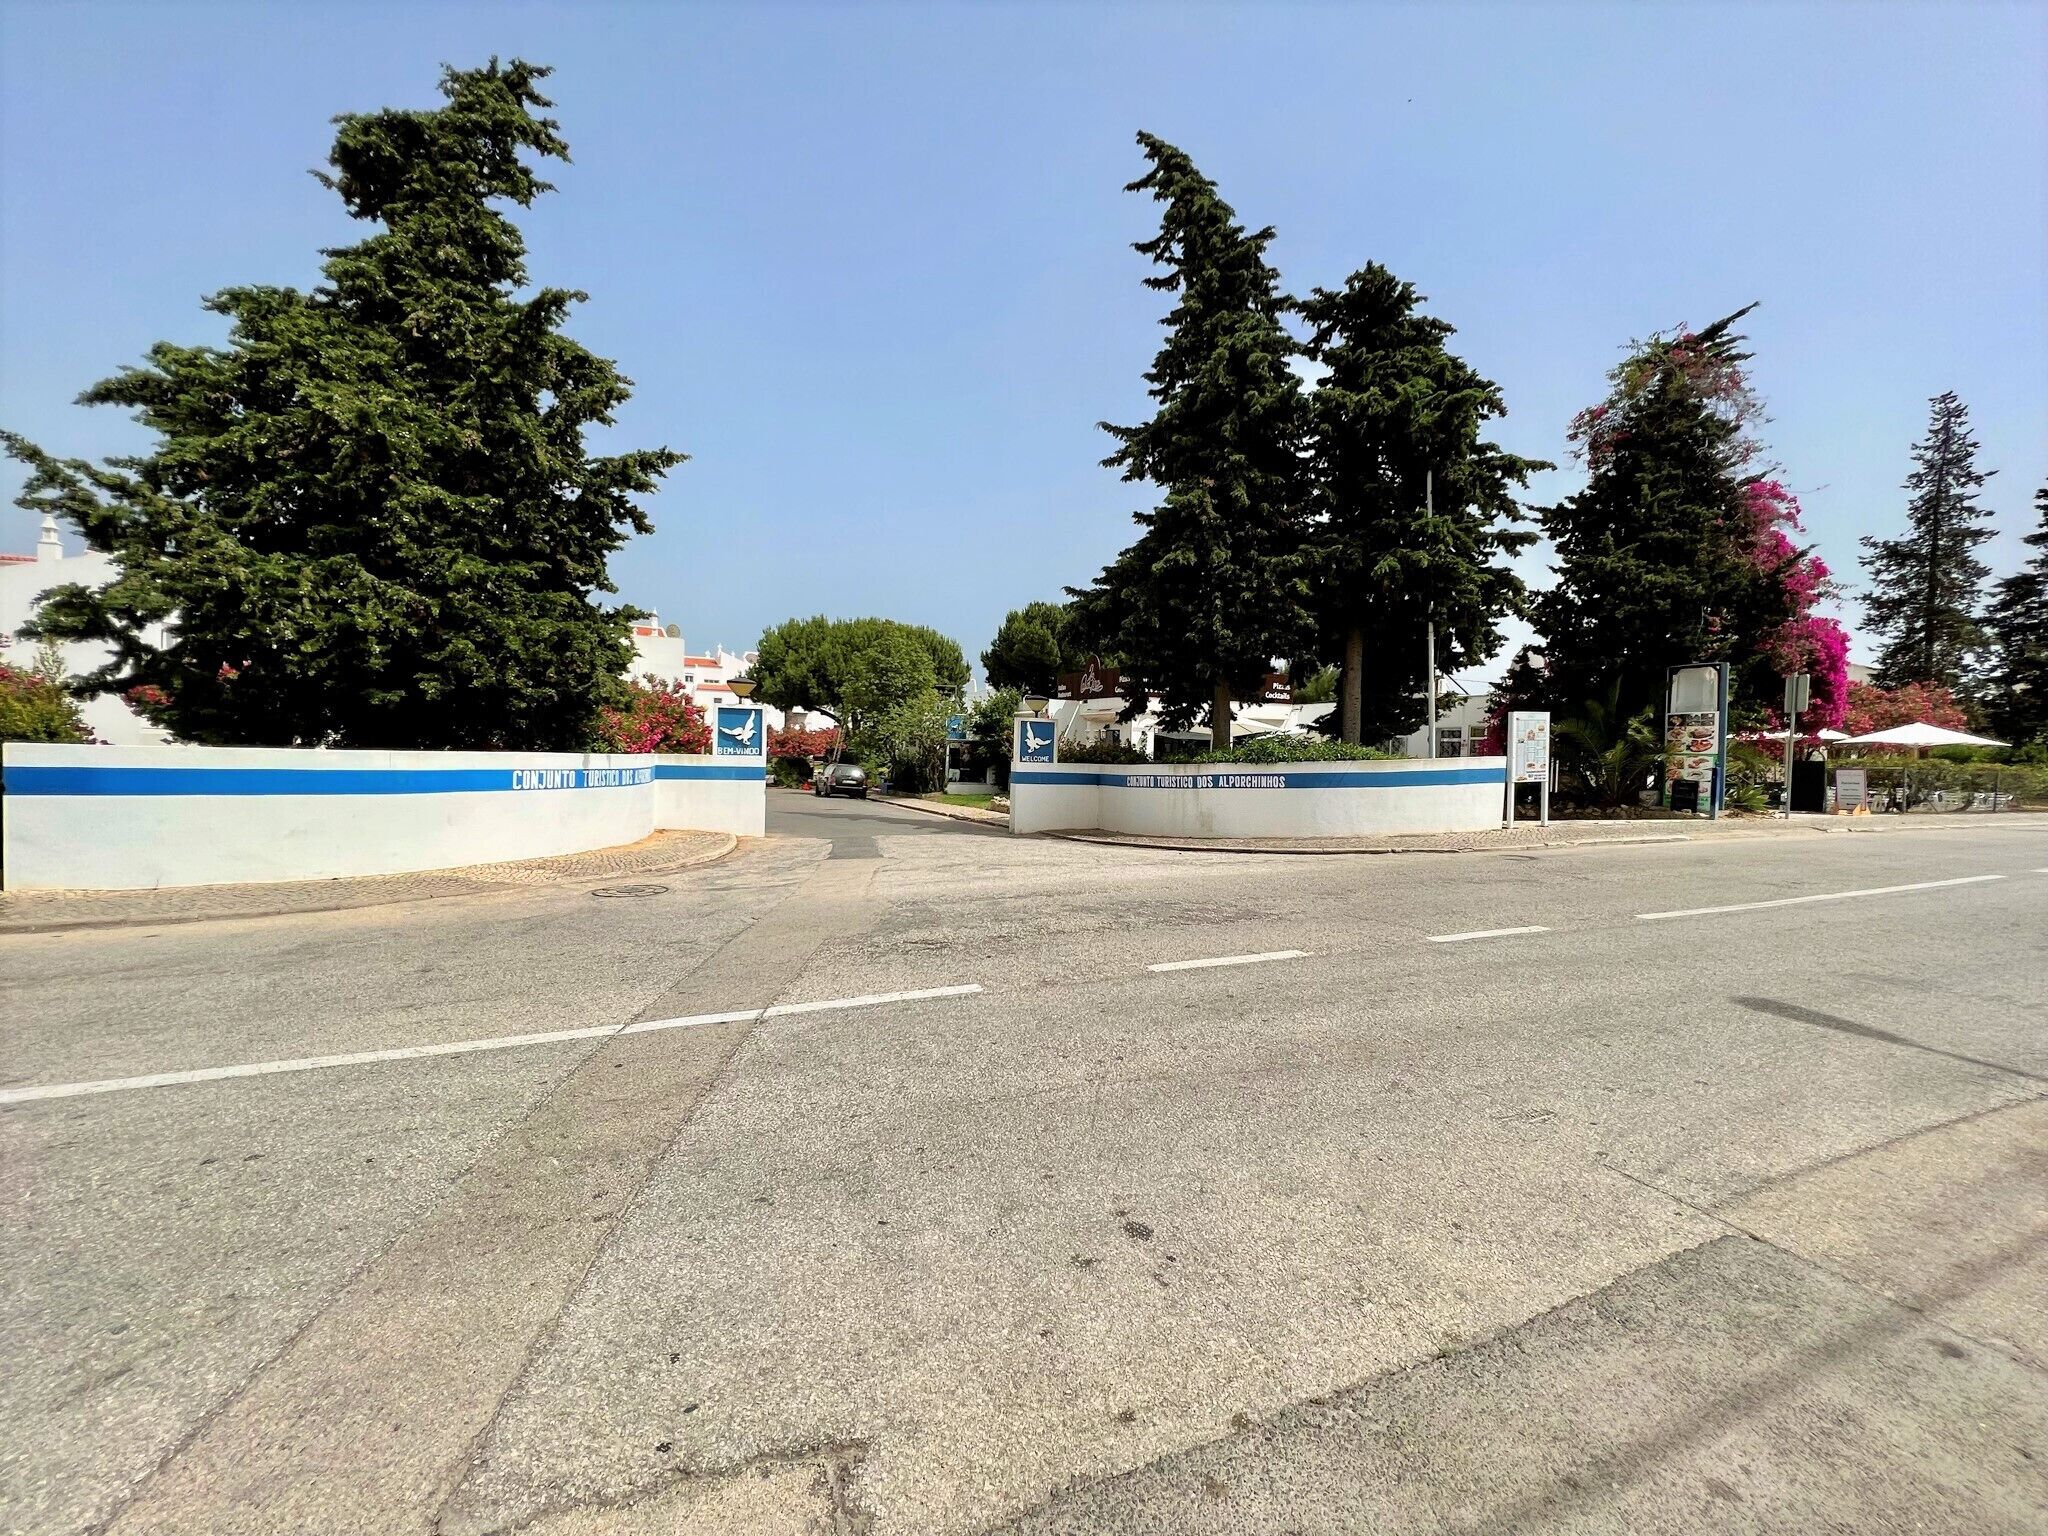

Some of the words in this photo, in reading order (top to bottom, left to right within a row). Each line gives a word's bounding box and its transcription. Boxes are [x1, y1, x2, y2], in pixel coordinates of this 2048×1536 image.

[1265, 691, 1291, 700] Cocktails
[717, 746, 760, 755] BEM-VINDO
[512, 769, 576, 790] CONJUNTO
[1126, 775, 1154, 787] CONJUNTO
[1157, 776, 1193, 788] TURISTICO
[1197, 775, 1214, 788] DOS
[1218, 775, 1286, 788] ALPORCHINHOS
